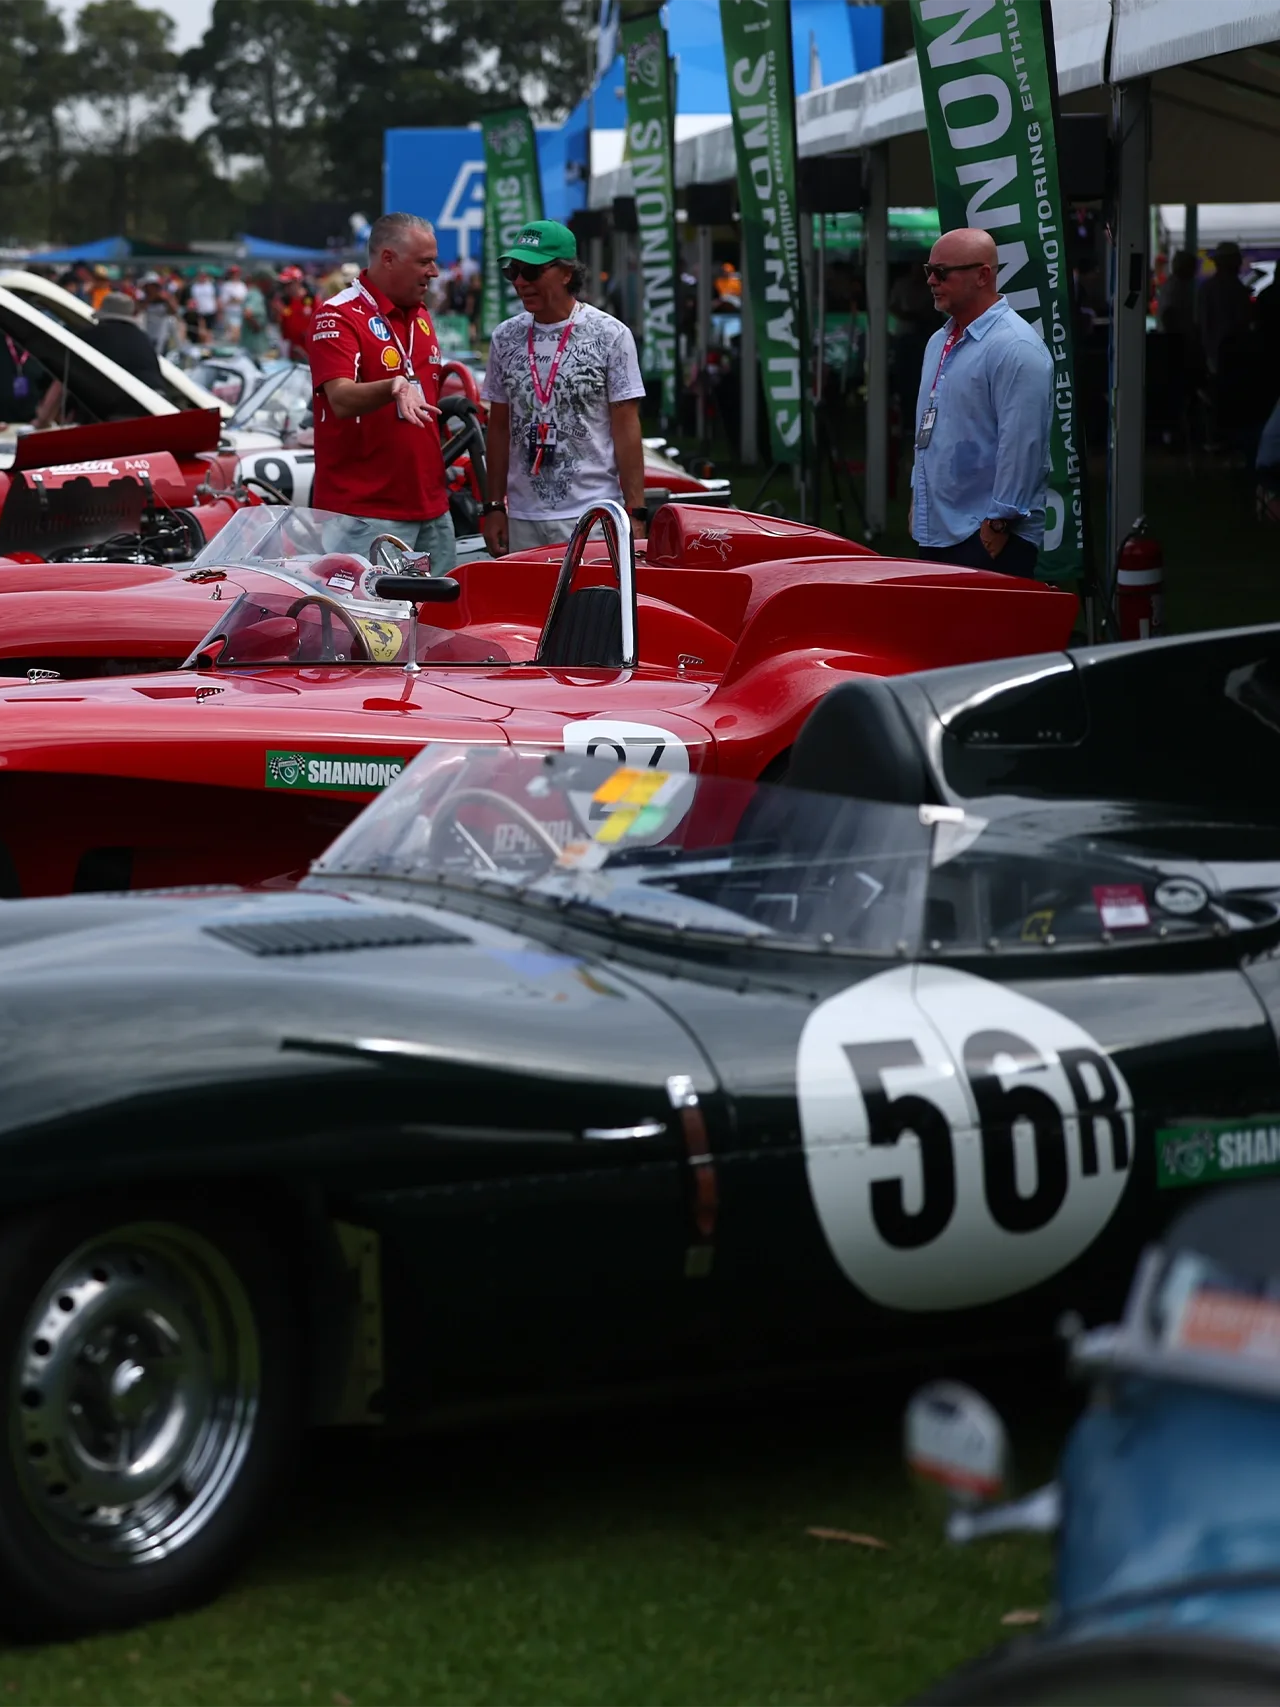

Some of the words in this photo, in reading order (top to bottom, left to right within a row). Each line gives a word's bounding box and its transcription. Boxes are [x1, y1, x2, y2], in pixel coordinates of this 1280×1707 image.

[1028, 122, 1060, 289] MOTORING
[316, 320, 336, 330] ZCG
[124, 460, 150, 470] A40
[308, 760, 402, 787] SHANNONS
[841, 1028, 1128, 1251] 56R
